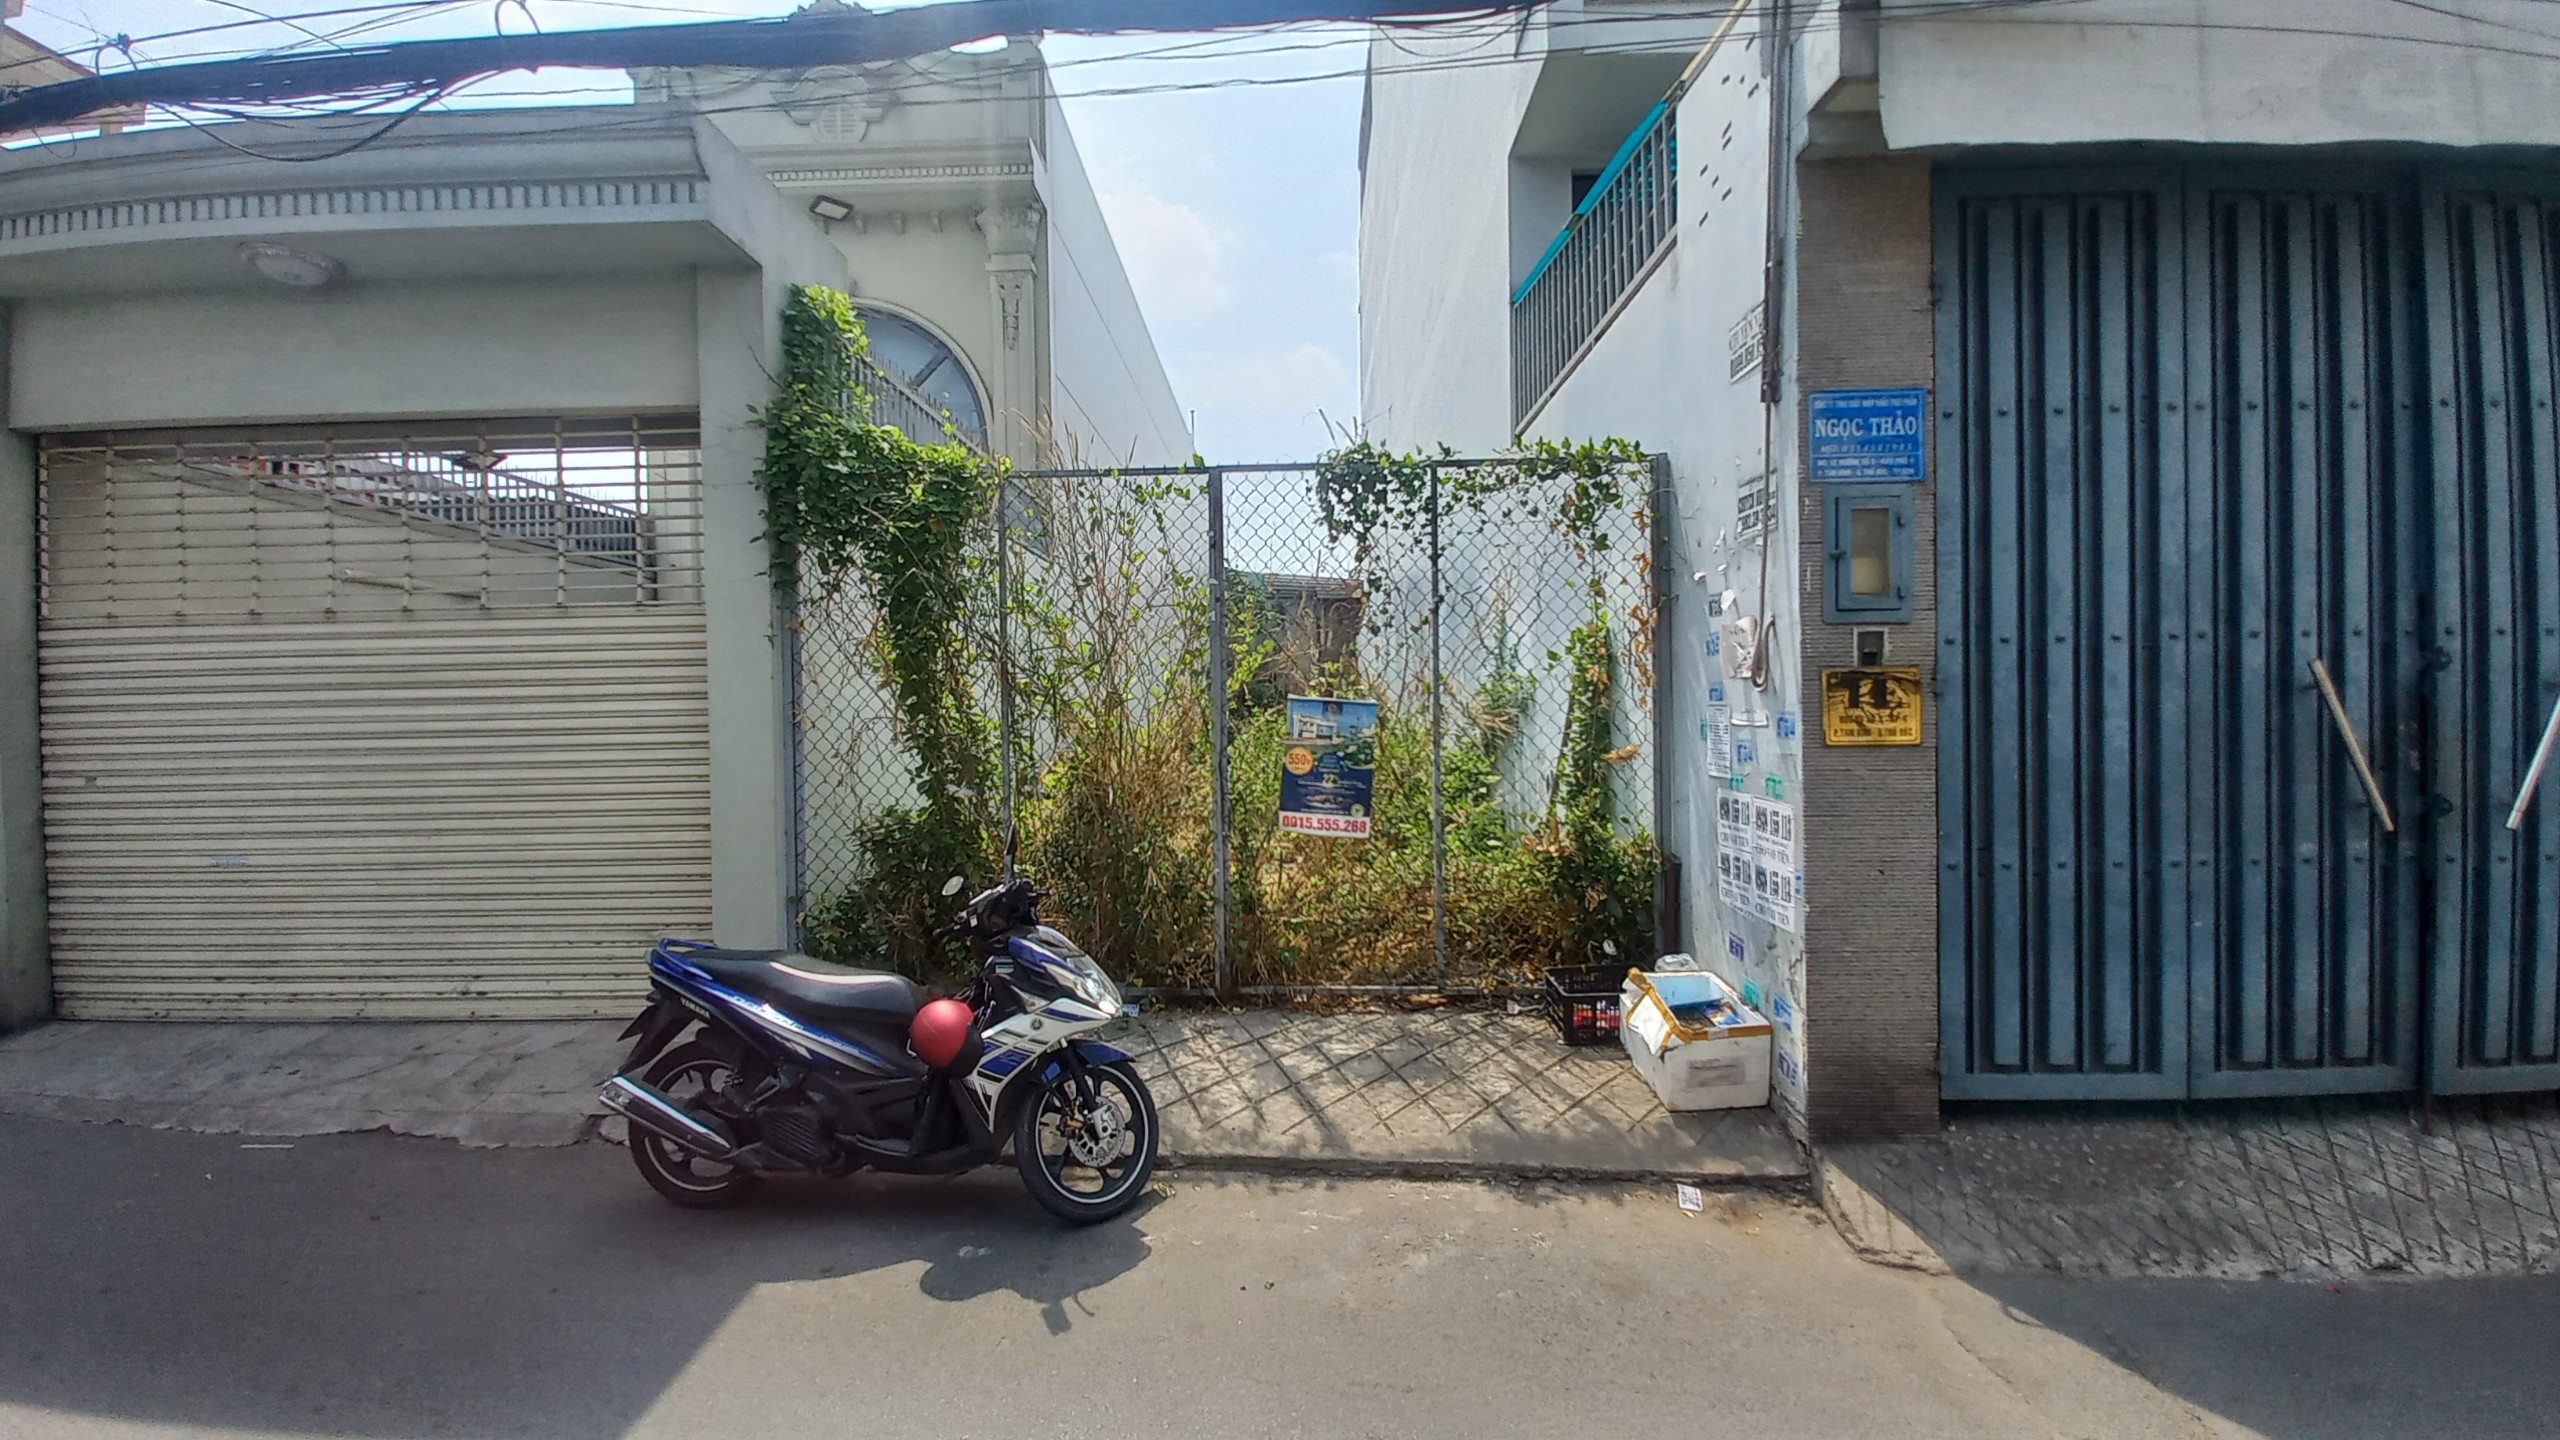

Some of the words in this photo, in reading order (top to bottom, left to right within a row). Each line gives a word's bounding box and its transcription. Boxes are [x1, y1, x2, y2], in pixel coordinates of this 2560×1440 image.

[1814, 417, 1864, 441] NGỌC
[1868, 409, 1918, 437] THẢO
[1282, 815, 1367, 834] 0915.555.268
[680, 997, 711, 1020] YAMAHA
